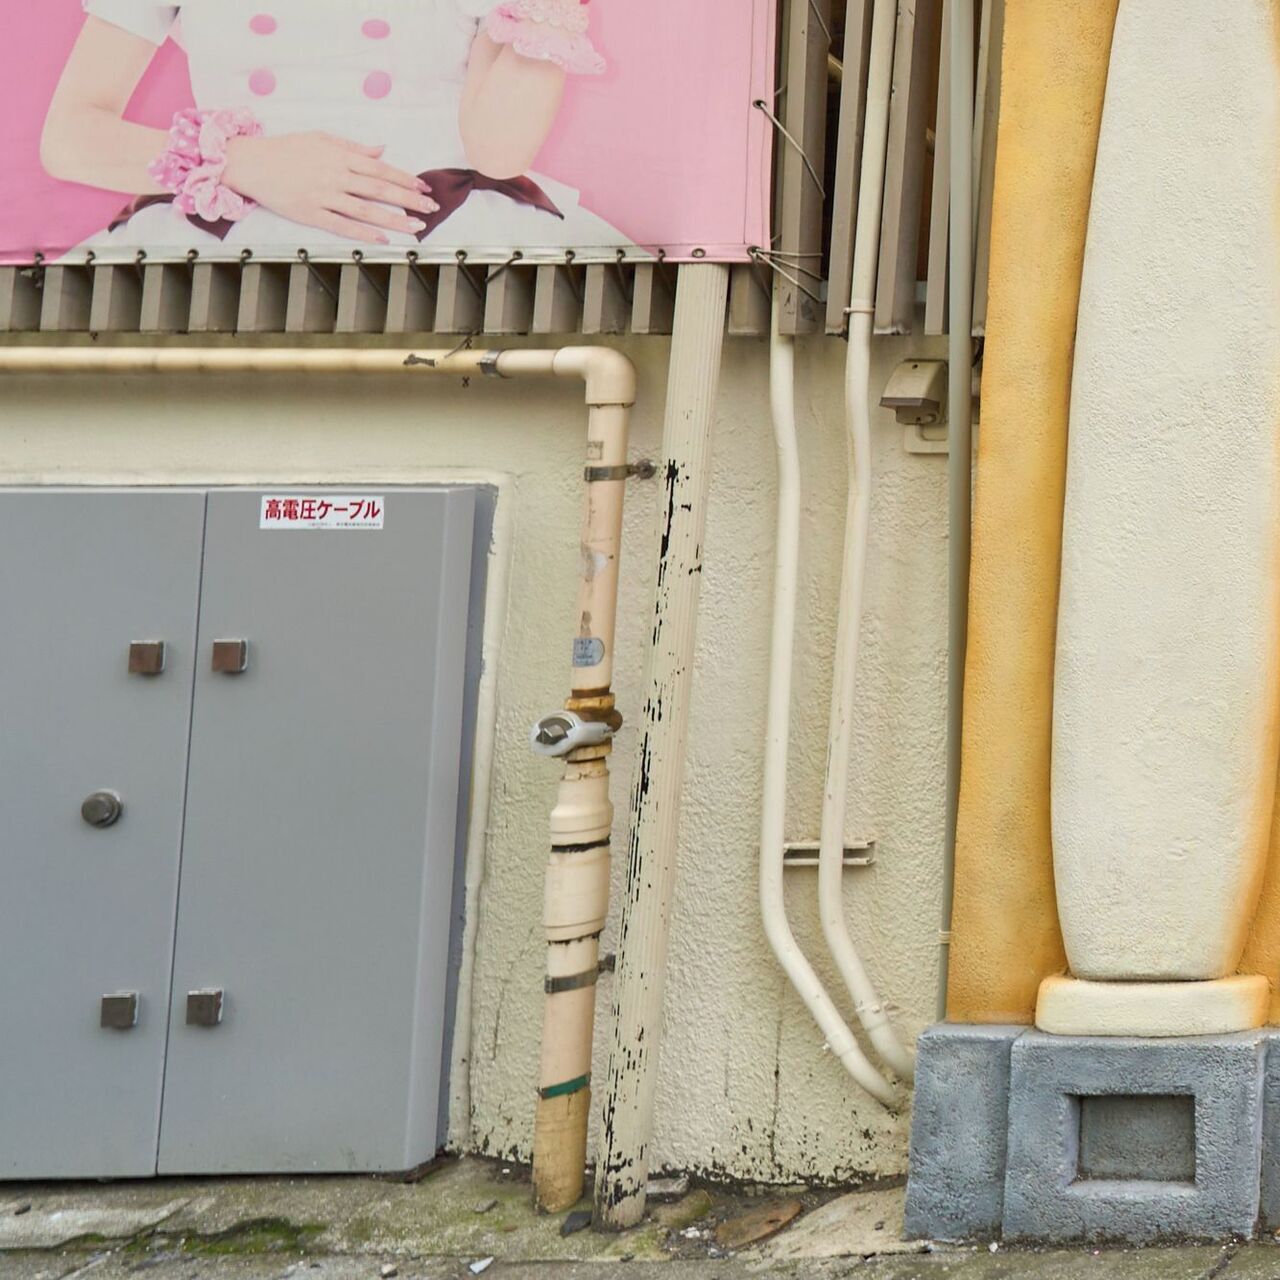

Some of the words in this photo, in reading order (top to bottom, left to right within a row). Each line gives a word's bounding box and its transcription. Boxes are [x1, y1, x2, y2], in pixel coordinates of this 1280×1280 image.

[265, 498, 381, 521] 高電圧ケーブル
